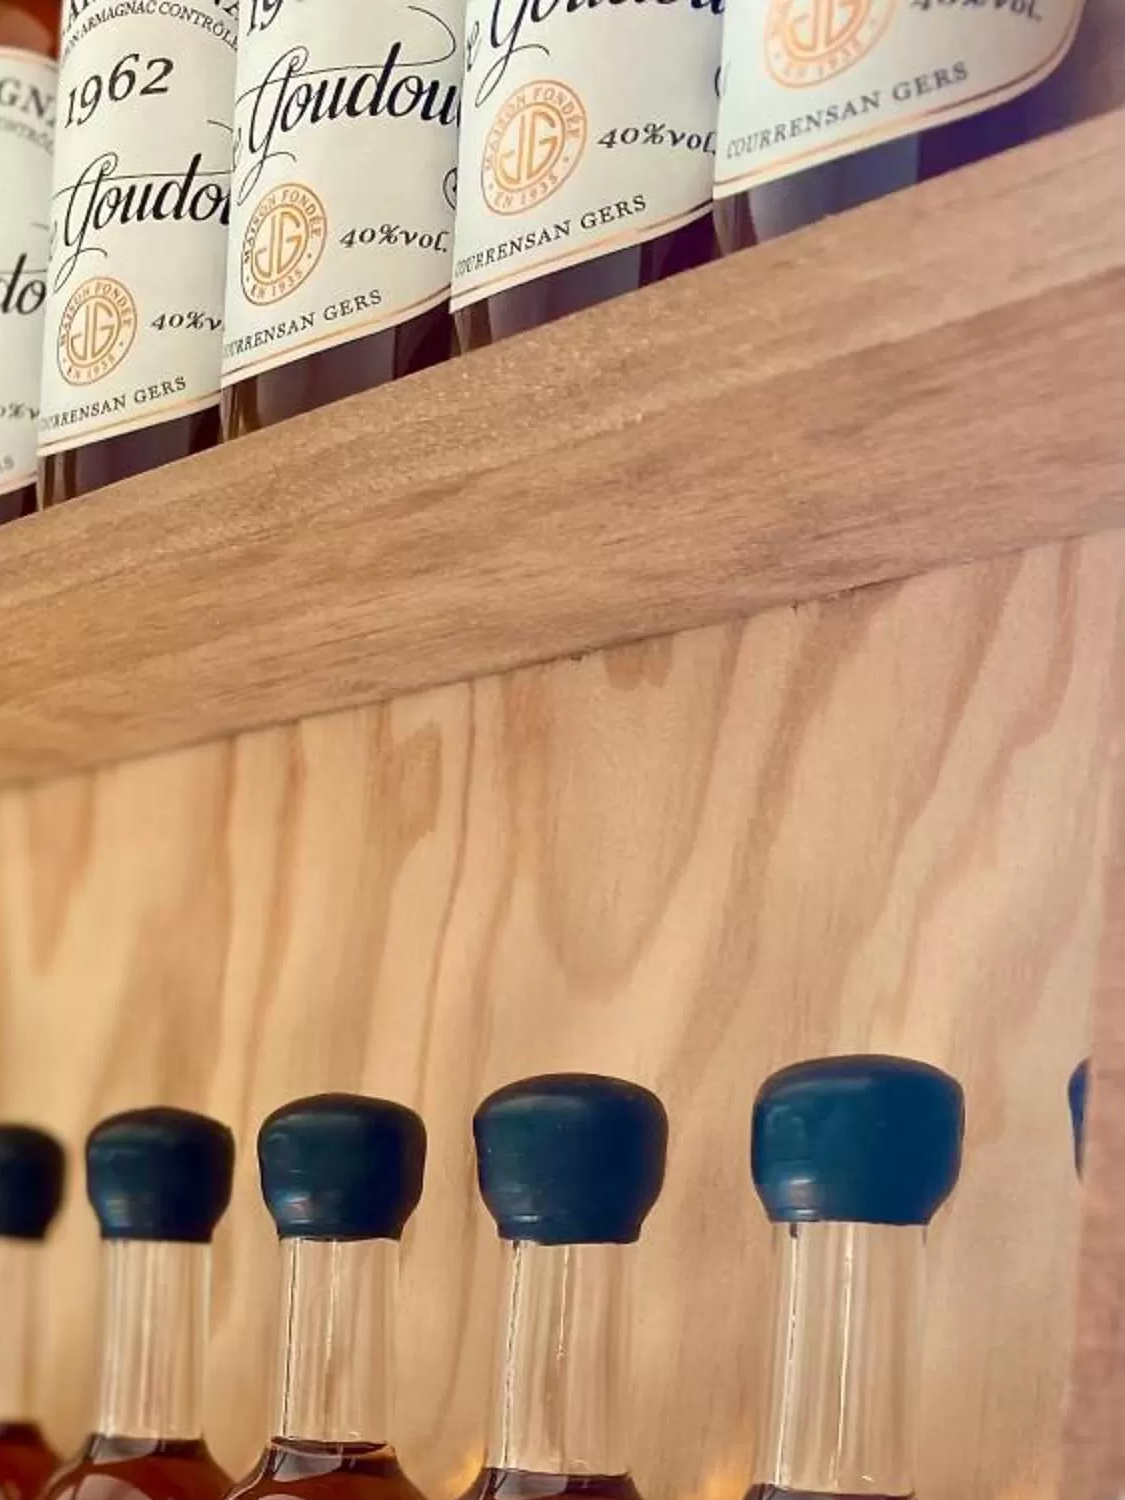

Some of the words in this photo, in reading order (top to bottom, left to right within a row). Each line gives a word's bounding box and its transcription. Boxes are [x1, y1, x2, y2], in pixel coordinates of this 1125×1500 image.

[64, 53, 174, 128] 1962
[726, 90, 881, 160] COURRENSAN
[892, 61, 969, 102] GERS
[580, 194, 647, 229] GERS
[339, 223, 450, 253] 40%vol.
[323, 289, 383, 322] GERS
[134, 376, 187, 404] GERS
